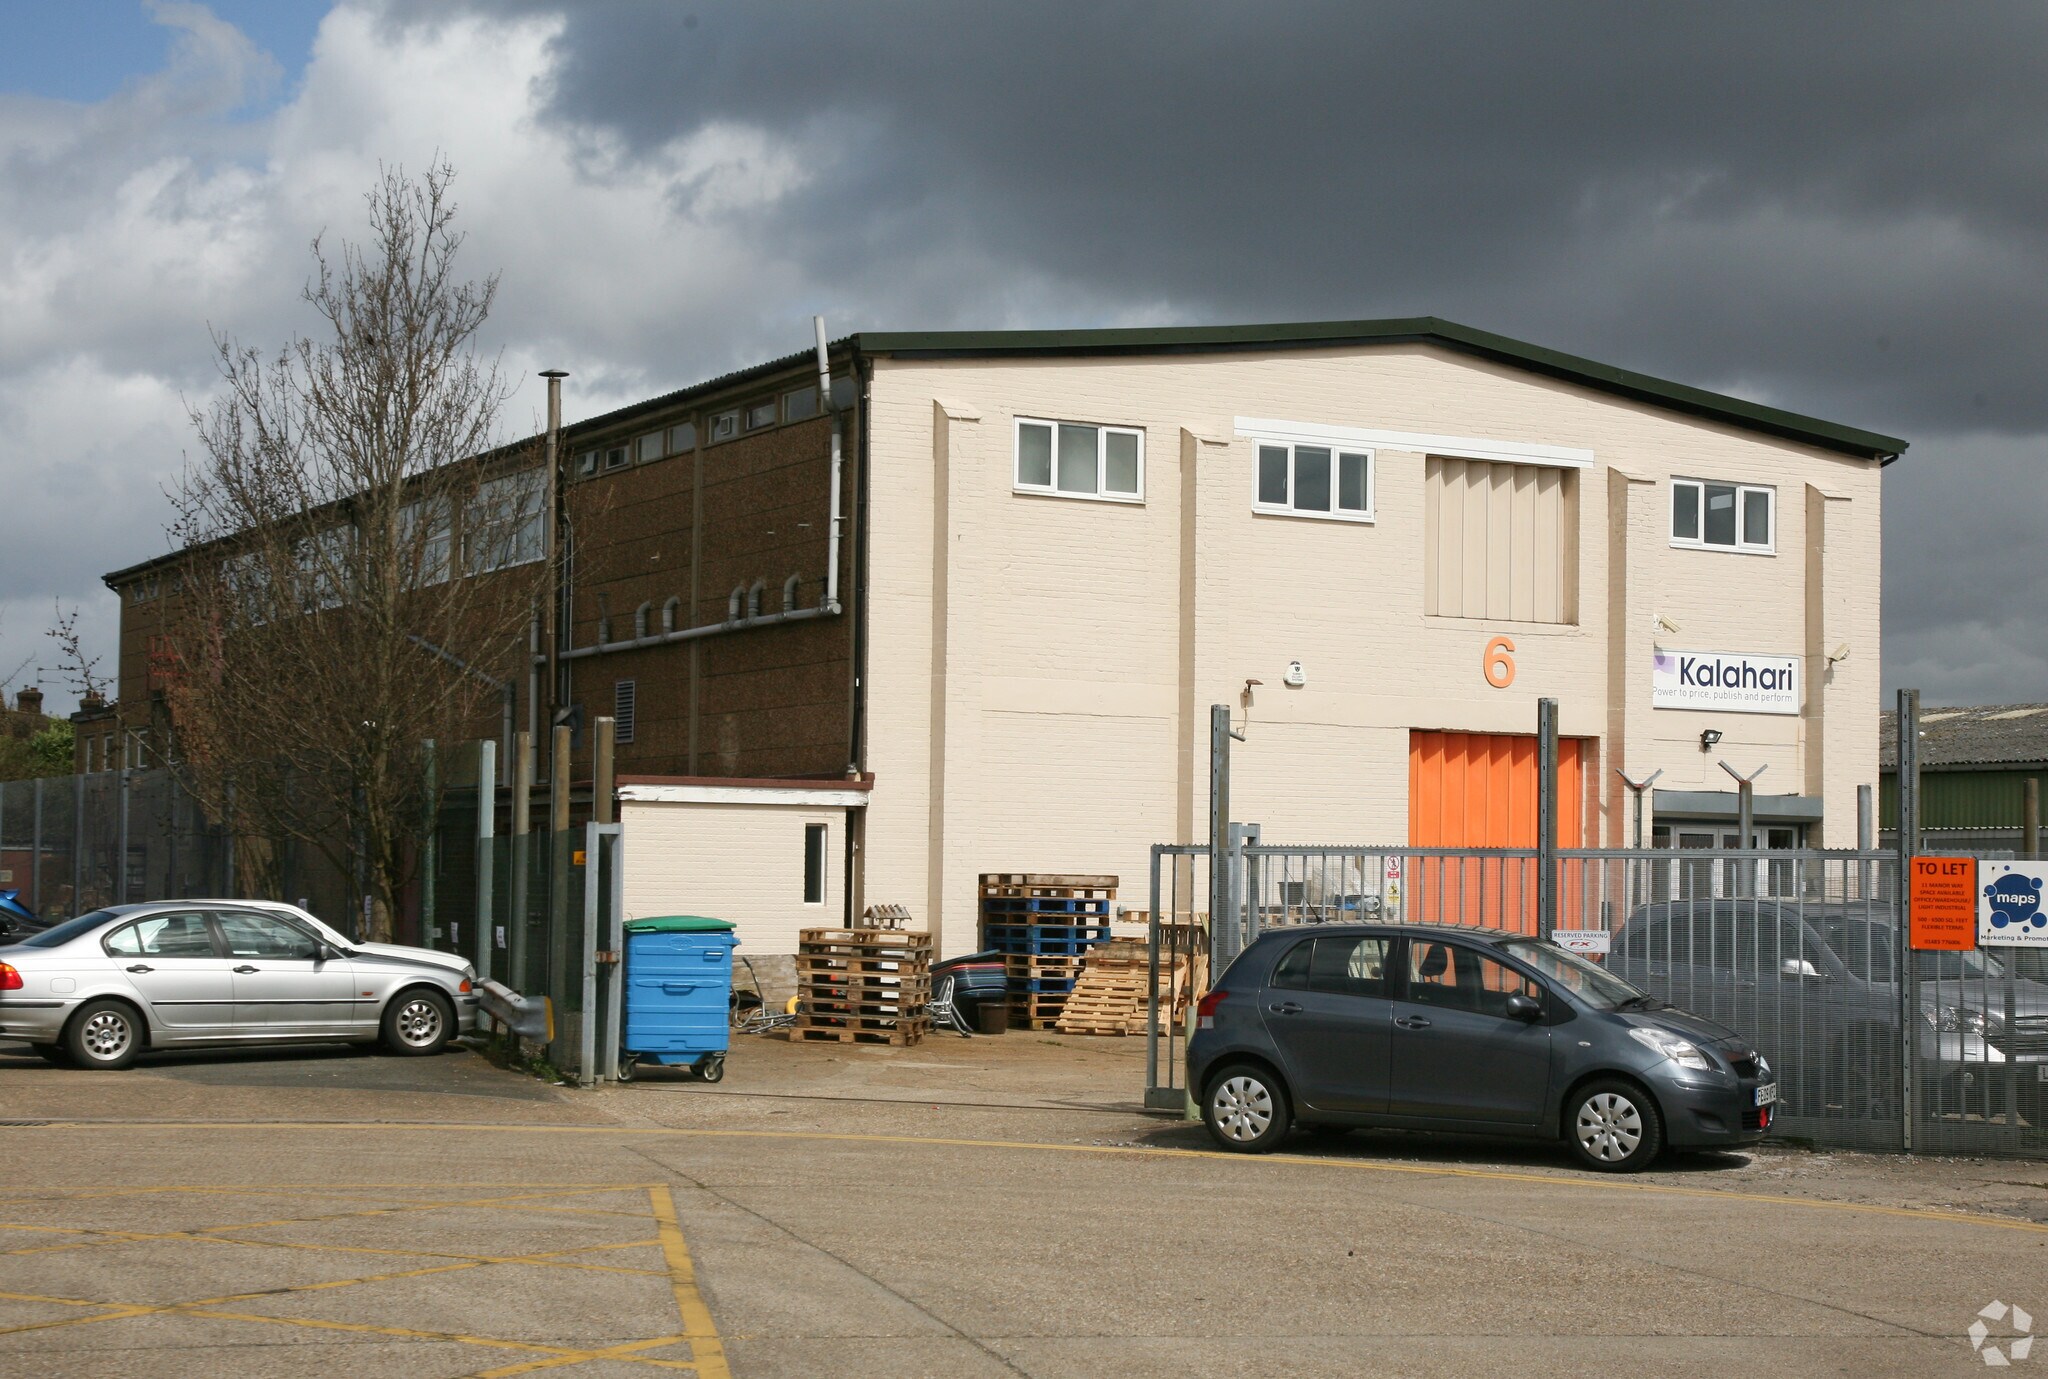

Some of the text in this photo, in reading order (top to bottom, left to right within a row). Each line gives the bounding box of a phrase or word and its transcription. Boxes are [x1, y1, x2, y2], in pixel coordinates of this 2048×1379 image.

[1483, 636, 1515, 689] 6
[1680, 657, 1792, 691] Kalahari
[1653, 686, 1793, 703] Power to price, publish and perform
[1917, 862, 1968, 875] TO LET
[1996, 893, 2036, 907] maps
